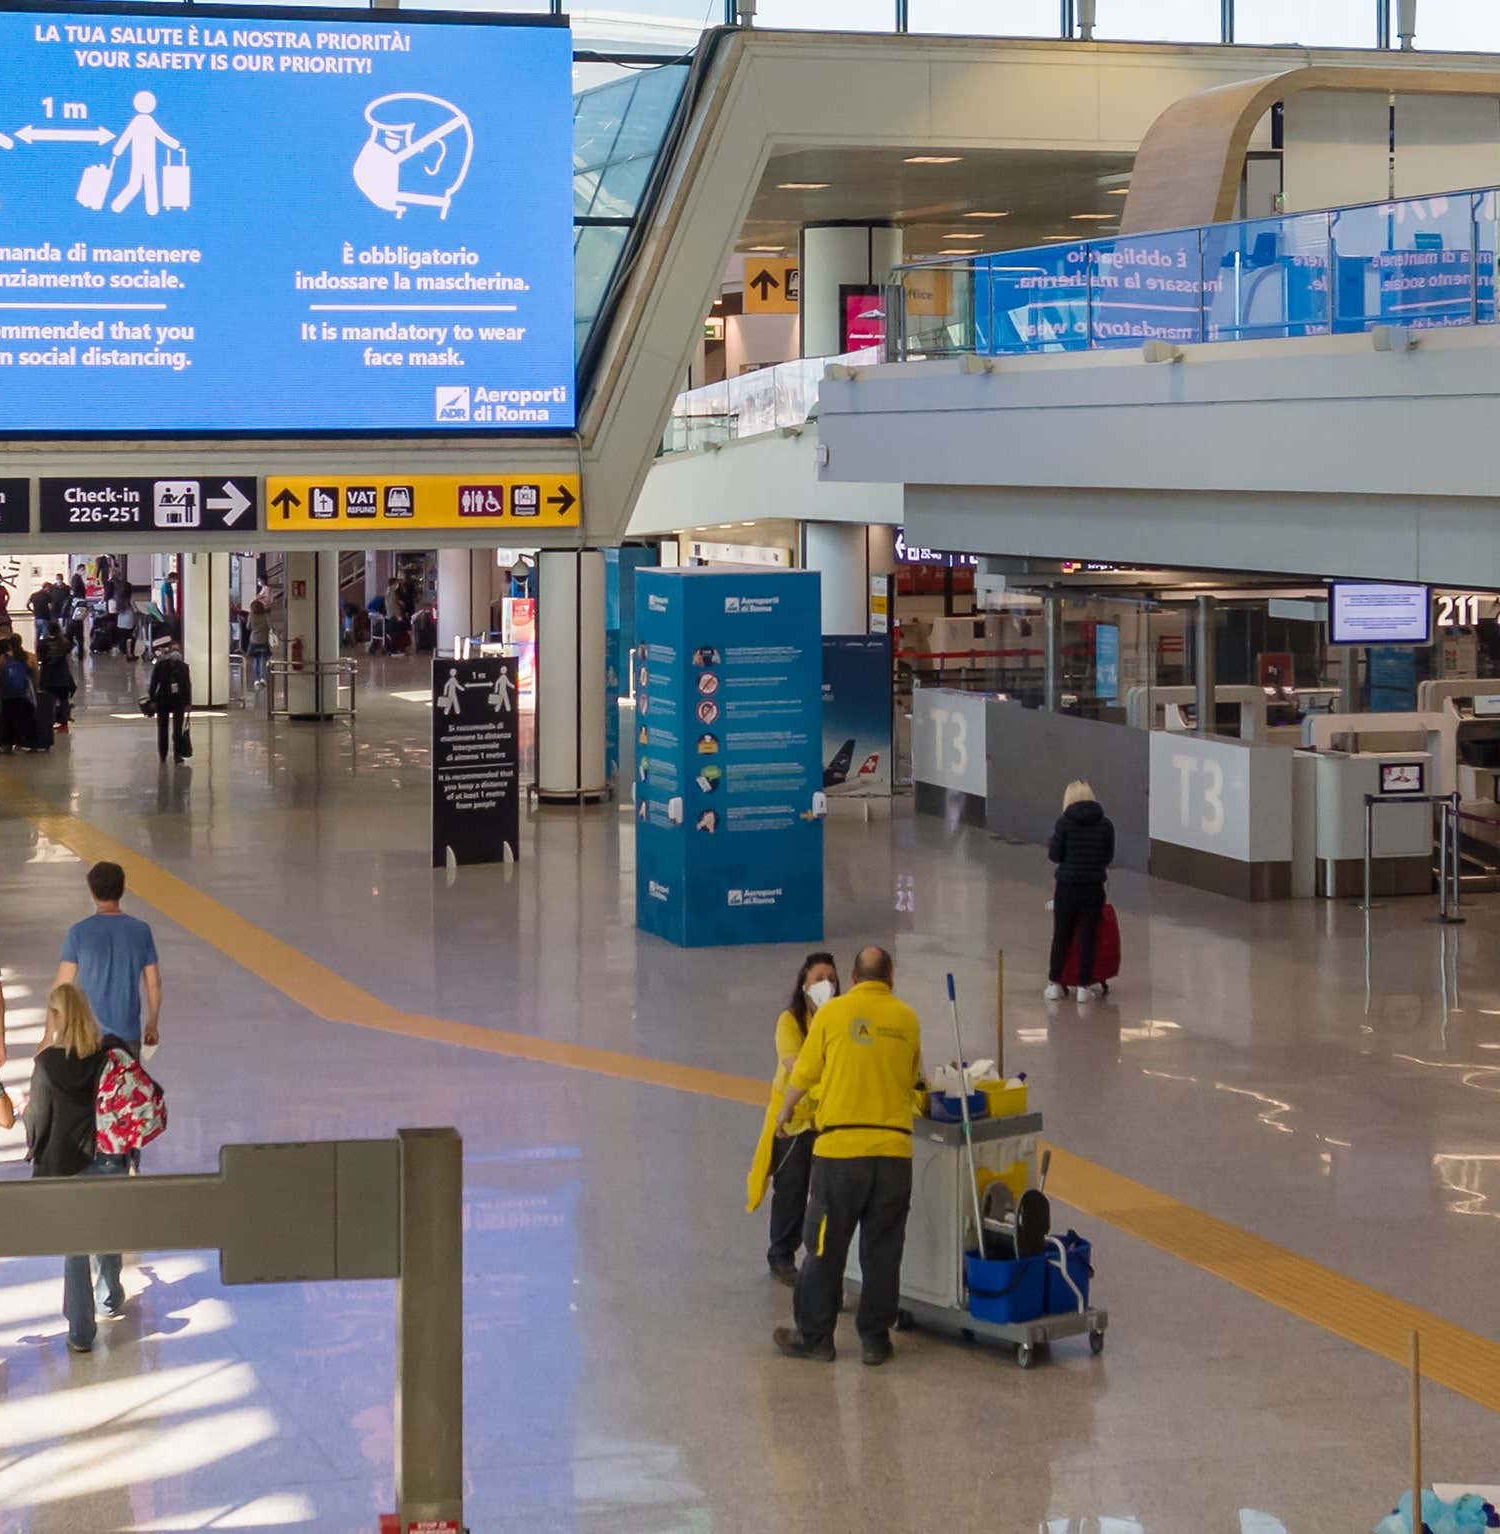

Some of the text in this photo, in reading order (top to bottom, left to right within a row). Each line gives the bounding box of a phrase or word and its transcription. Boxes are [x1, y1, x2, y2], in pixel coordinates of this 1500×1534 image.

[35, 23, 411, 51] LA TUA SALUTE È LA NOSTRA PRIORITÀ!
[75, 50, 372, 74] YOUR SAFETY IS OUR PRIORITY!
[41, 97, 88, 119] 1 m
[67, 243, 87, 263] di
[92, 247, 201, 264] mantenere
[343, 241, 479, 269] È obbligatorio
[110, 269, 185, 289] sociale.
[295, 271, 530, 291] indossare la mascherina.
[110, 322, 151, 340] that
[156, 325, 194, 345] you
[302, 322, 526, 345] It is mandatory to wear
[19, 346, 76, 366] social
[82, 347, 192, 371] distancing.
[363, 347, 465, 367] face mask.
[474, 386, 566, 406] Aeroporti
[440, 408, 467, 420] ADR
[474, 405, 549, 422] di Roma
[64, 487, 140, 503] Check-in
[347, 491, 376, 504] VAT
[70, 507, 140, 522] 226-251
[1437, 596, 1478, 627] 211
[929, 709, 968, 776] T3
[1172, 754, 1224, 835] T3
